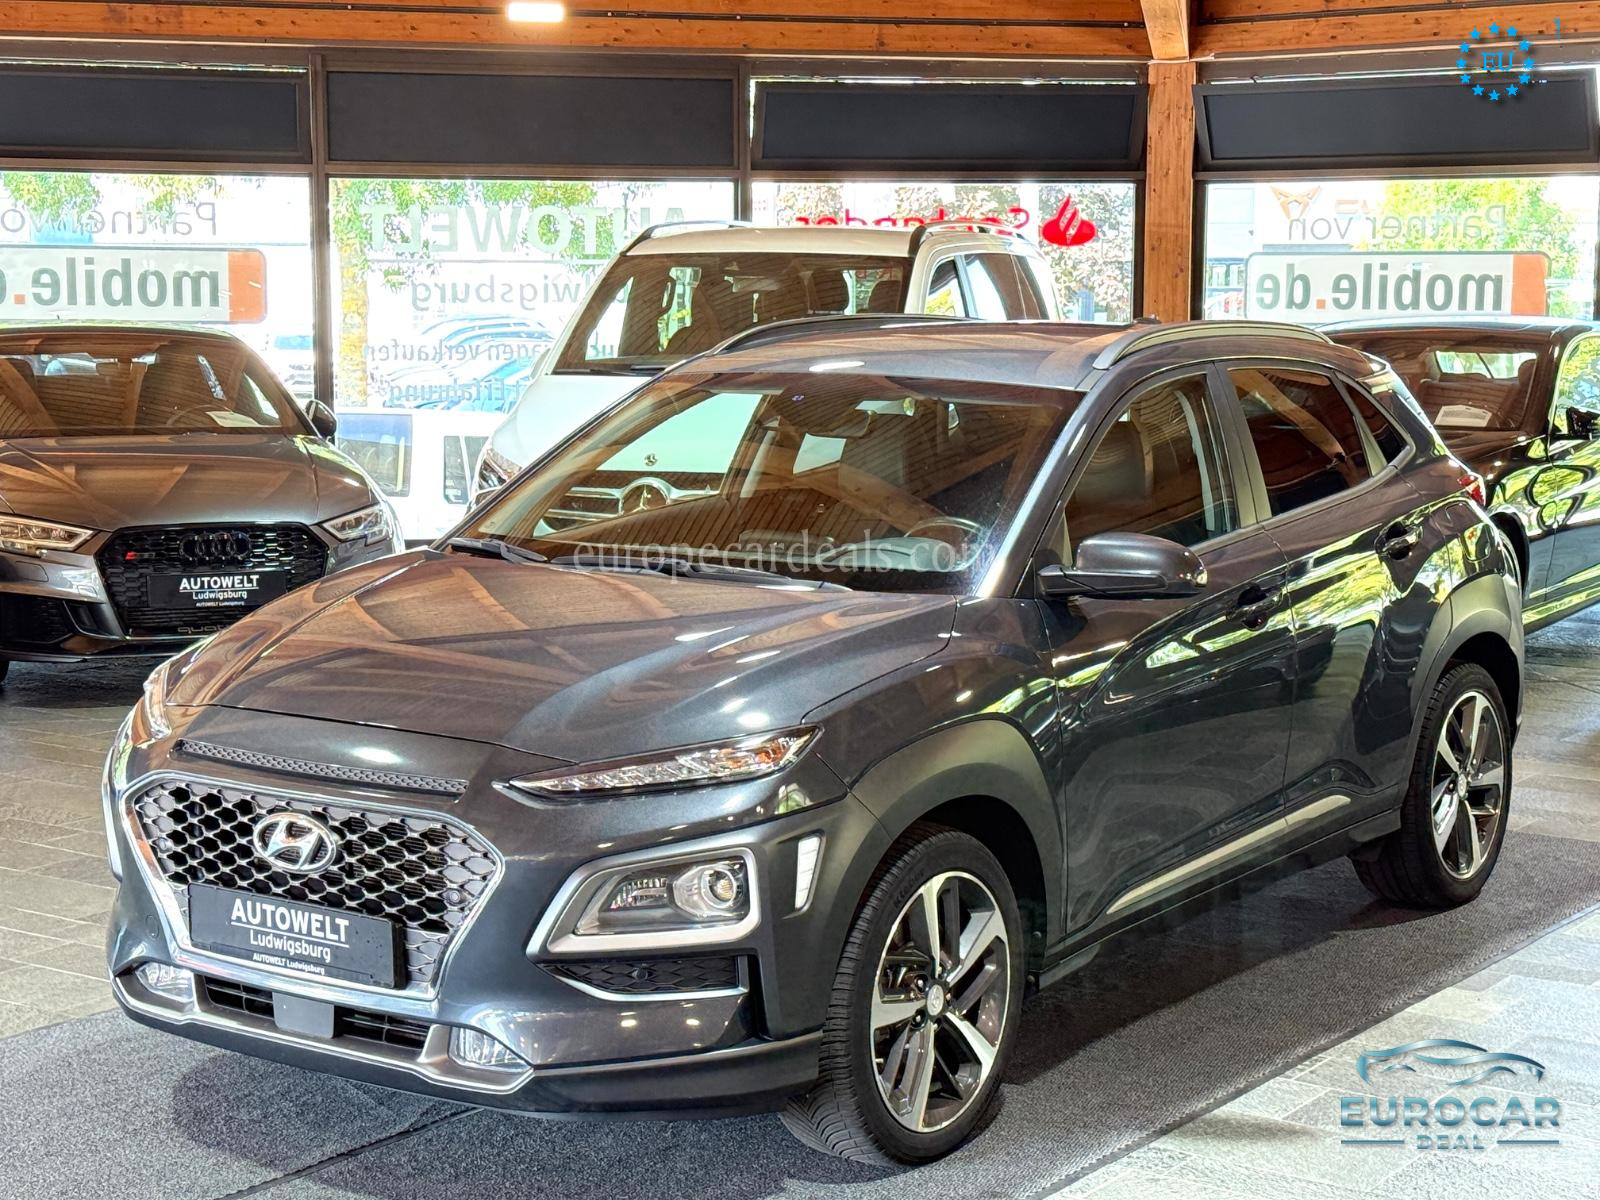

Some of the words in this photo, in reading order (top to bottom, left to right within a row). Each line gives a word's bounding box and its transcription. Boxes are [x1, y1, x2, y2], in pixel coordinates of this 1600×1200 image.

[180, 575, 260, 590] AUTOWELT
[193, 590, 247, 600] Ludwigsburg
[231, 898, 349, 943] AUTOWELT
[250, 929, 331, 963] Ludwigsburg
[253, 953, 286, 966] AUTOWELT
[286, 960, 325, 975] Ludwigsburg
